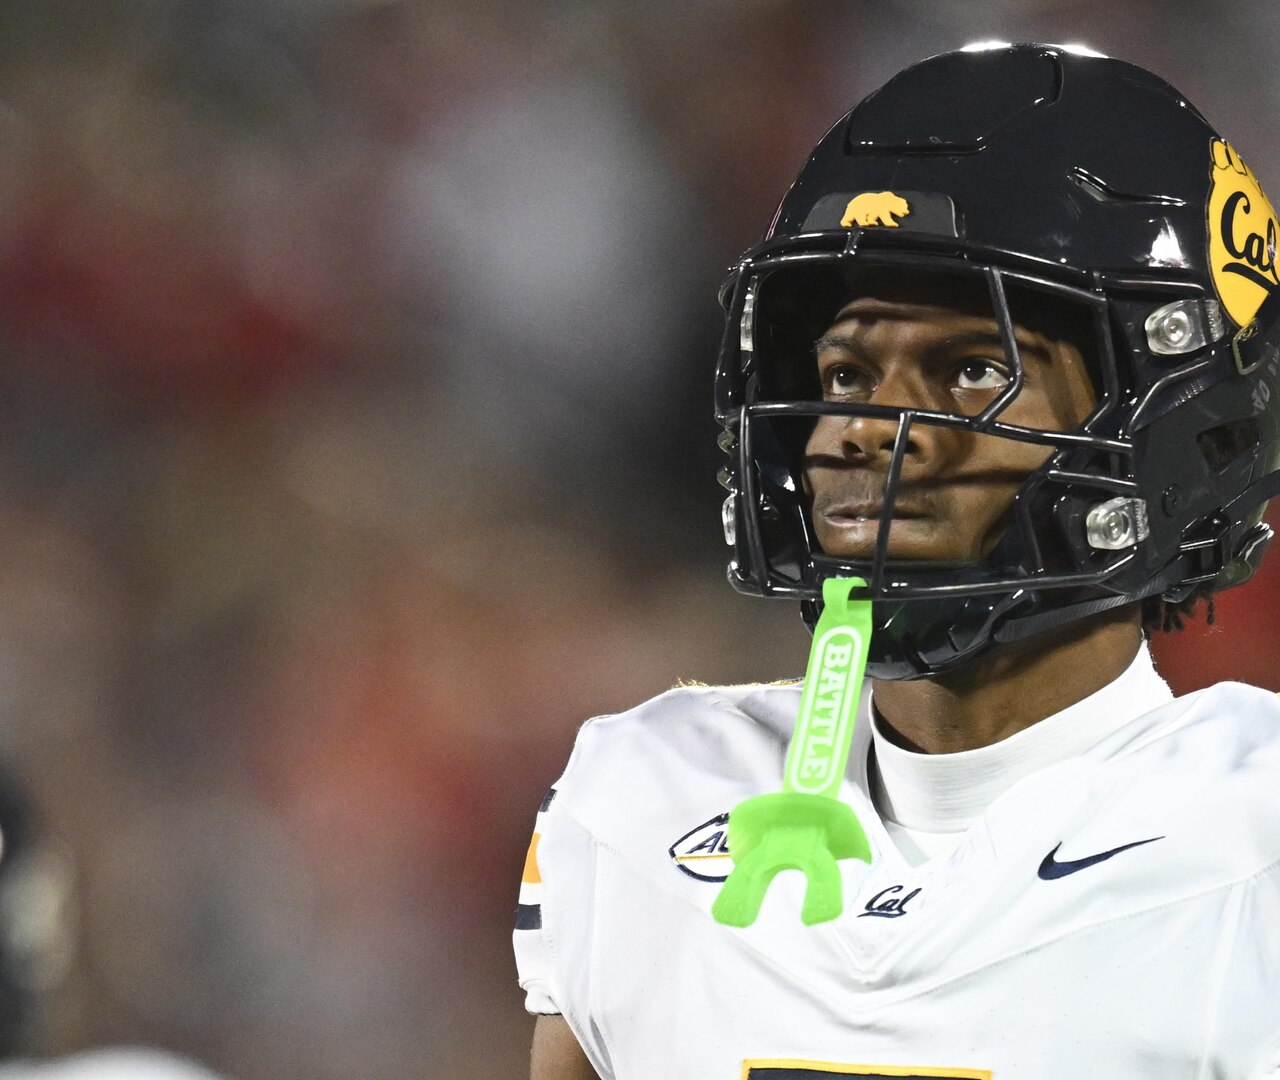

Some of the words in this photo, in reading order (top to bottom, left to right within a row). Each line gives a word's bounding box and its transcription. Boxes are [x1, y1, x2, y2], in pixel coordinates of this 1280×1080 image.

[1221, 191, 1280, 292] Cal
[799, 643, 853, 780] BATTLE
[857, 885, 923, 918] Cal
